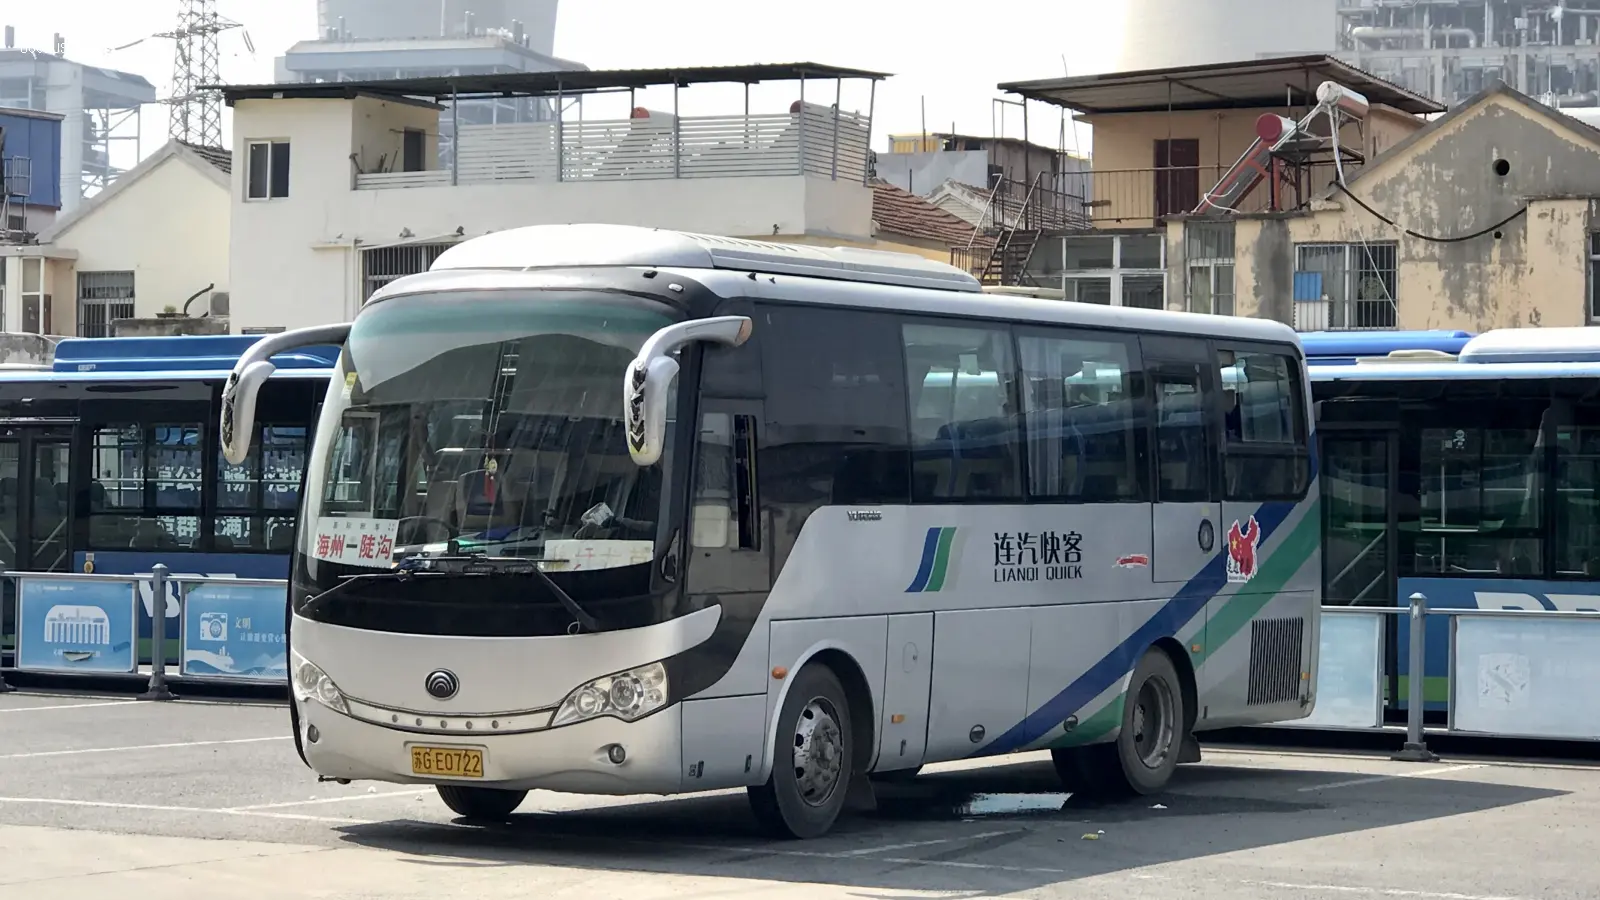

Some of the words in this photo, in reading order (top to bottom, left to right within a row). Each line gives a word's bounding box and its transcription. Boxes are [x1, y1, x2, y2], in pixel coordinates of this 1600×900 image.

[993, 530, 1083, 566] 连汽快客
[993, 566, 1039, 583] LIANQI
[1046, 565, 1083, 581] QUICK
